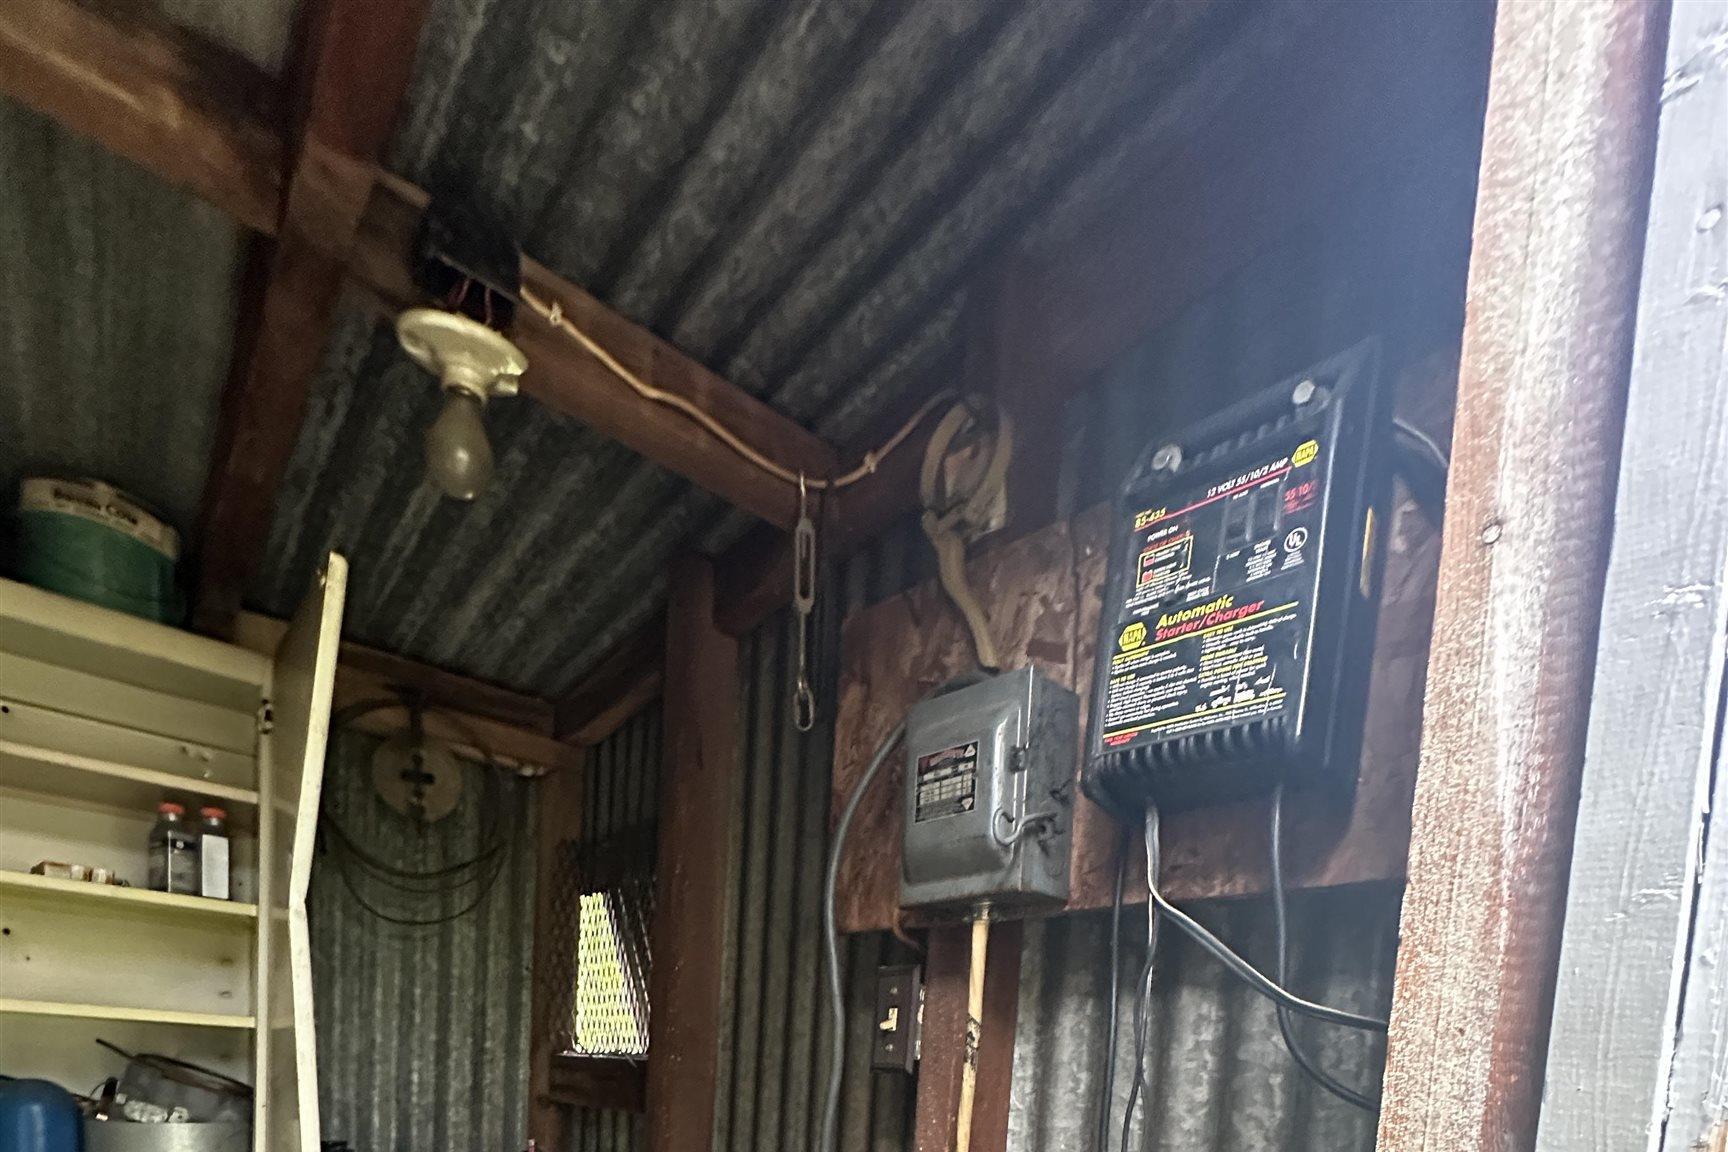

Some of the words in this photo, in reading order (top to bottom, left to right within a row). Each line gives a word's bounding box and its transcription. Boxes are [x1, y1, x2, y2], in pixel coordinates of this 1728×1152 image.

[1217, 478, 1236, 493] VOLT
[1268, 457, 1288, 473] AMP
[1155, 601, 1265, 641] Starter/Charger
[1156, 594, 1234, 629] Automatic
